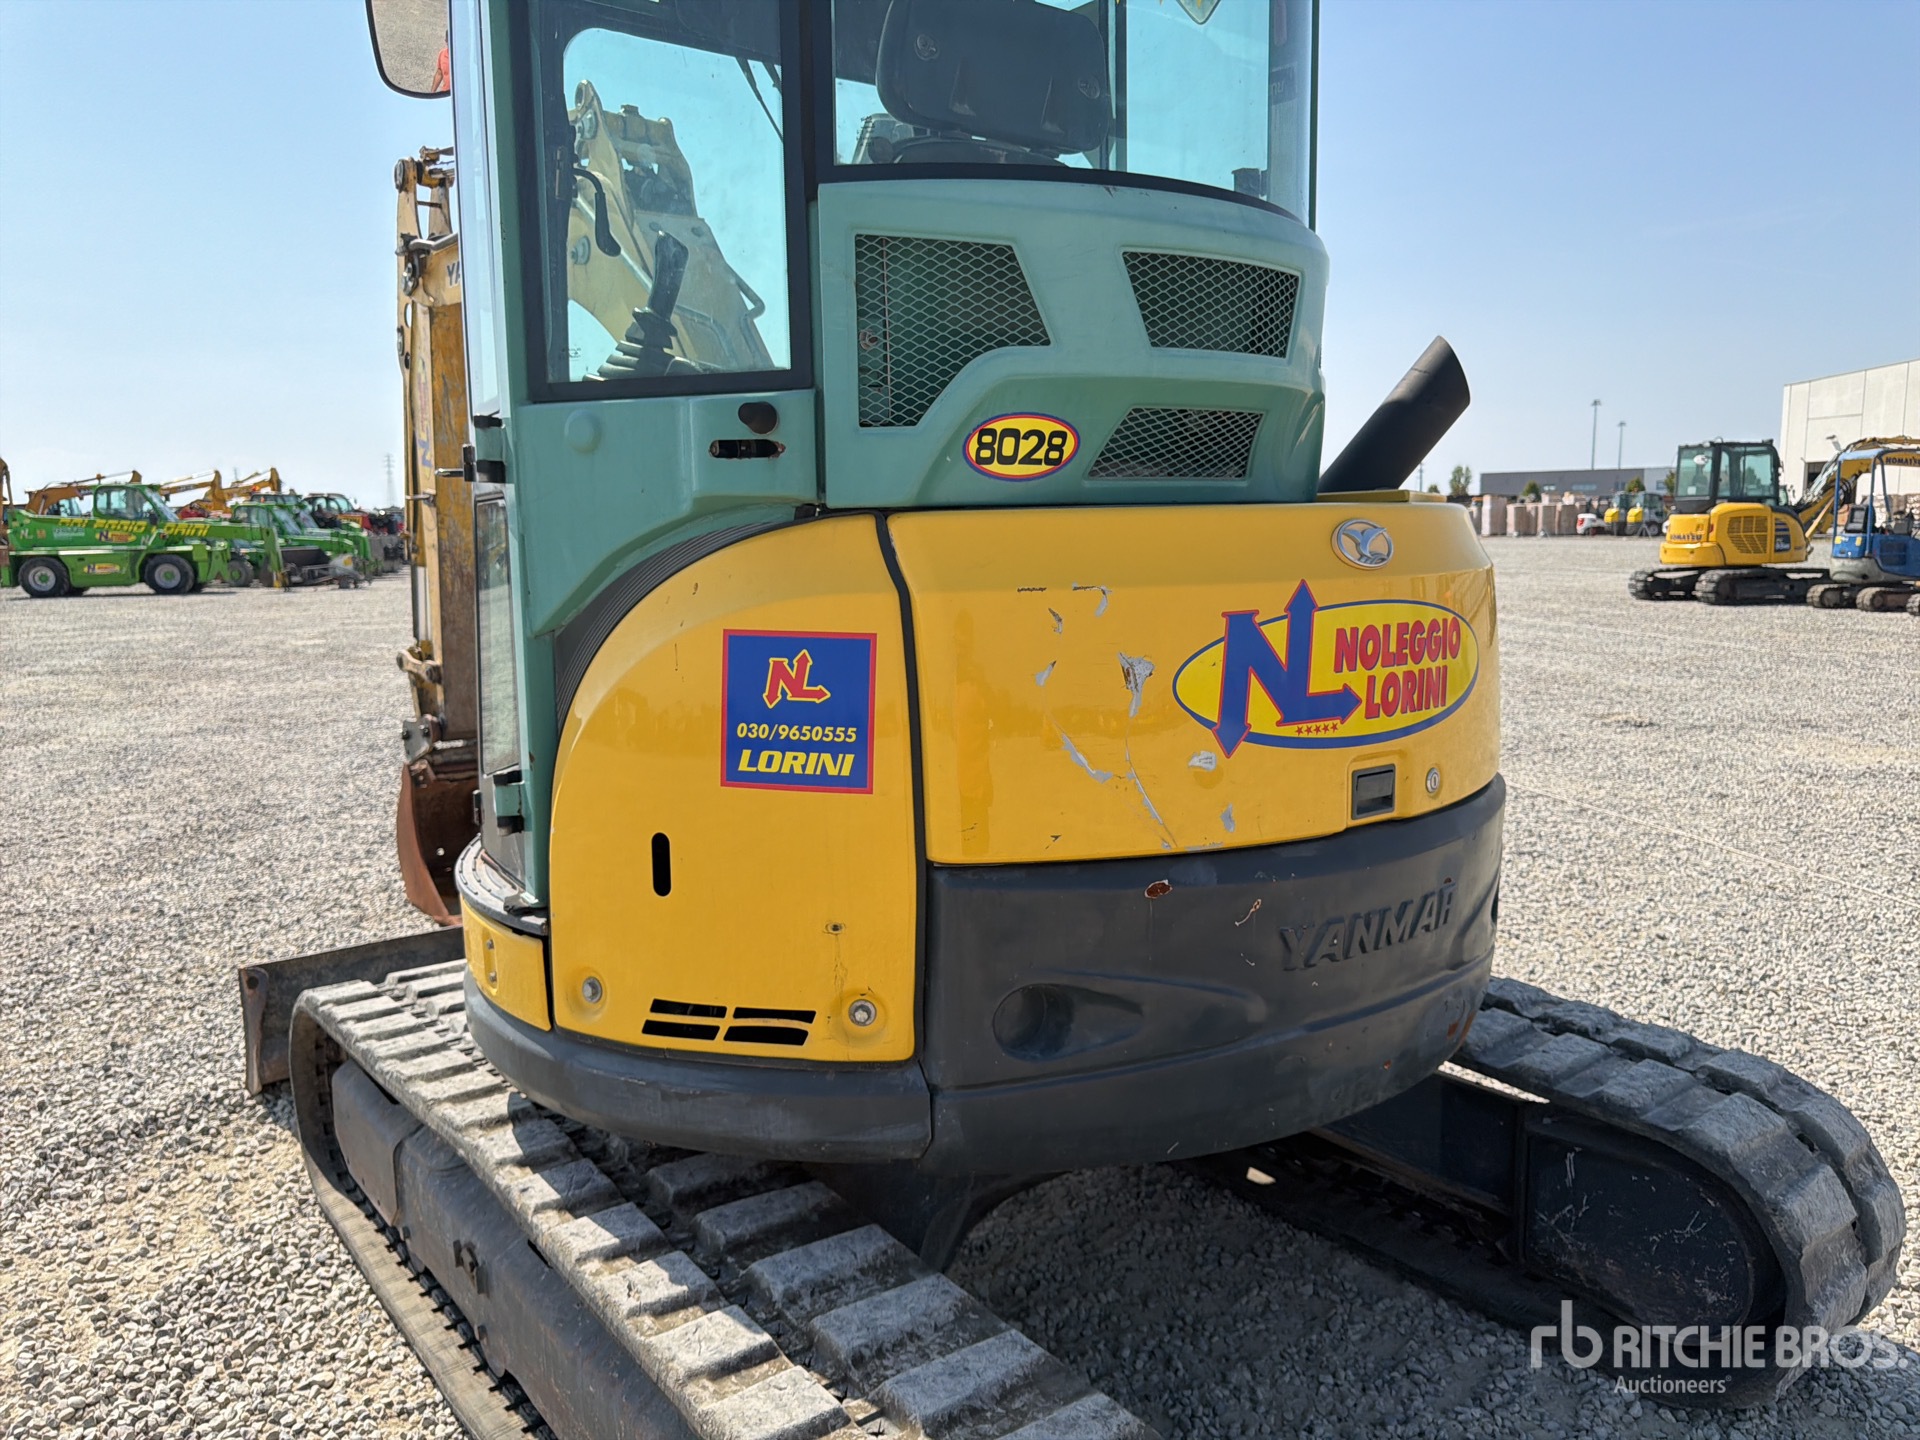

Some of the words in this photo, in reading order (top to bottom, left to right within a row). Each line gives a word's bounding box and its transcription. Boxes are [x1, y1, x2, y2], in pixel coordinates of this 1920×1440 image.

[975, 428, 1068, 466] 8028
[1333, 616, 1461, 673] NOLEGGIO
[1364, 665, 1448, 719] LORINI
[737, 722, 857, 743] 030/9650555
[738, 749, 855, 776] LORINI
